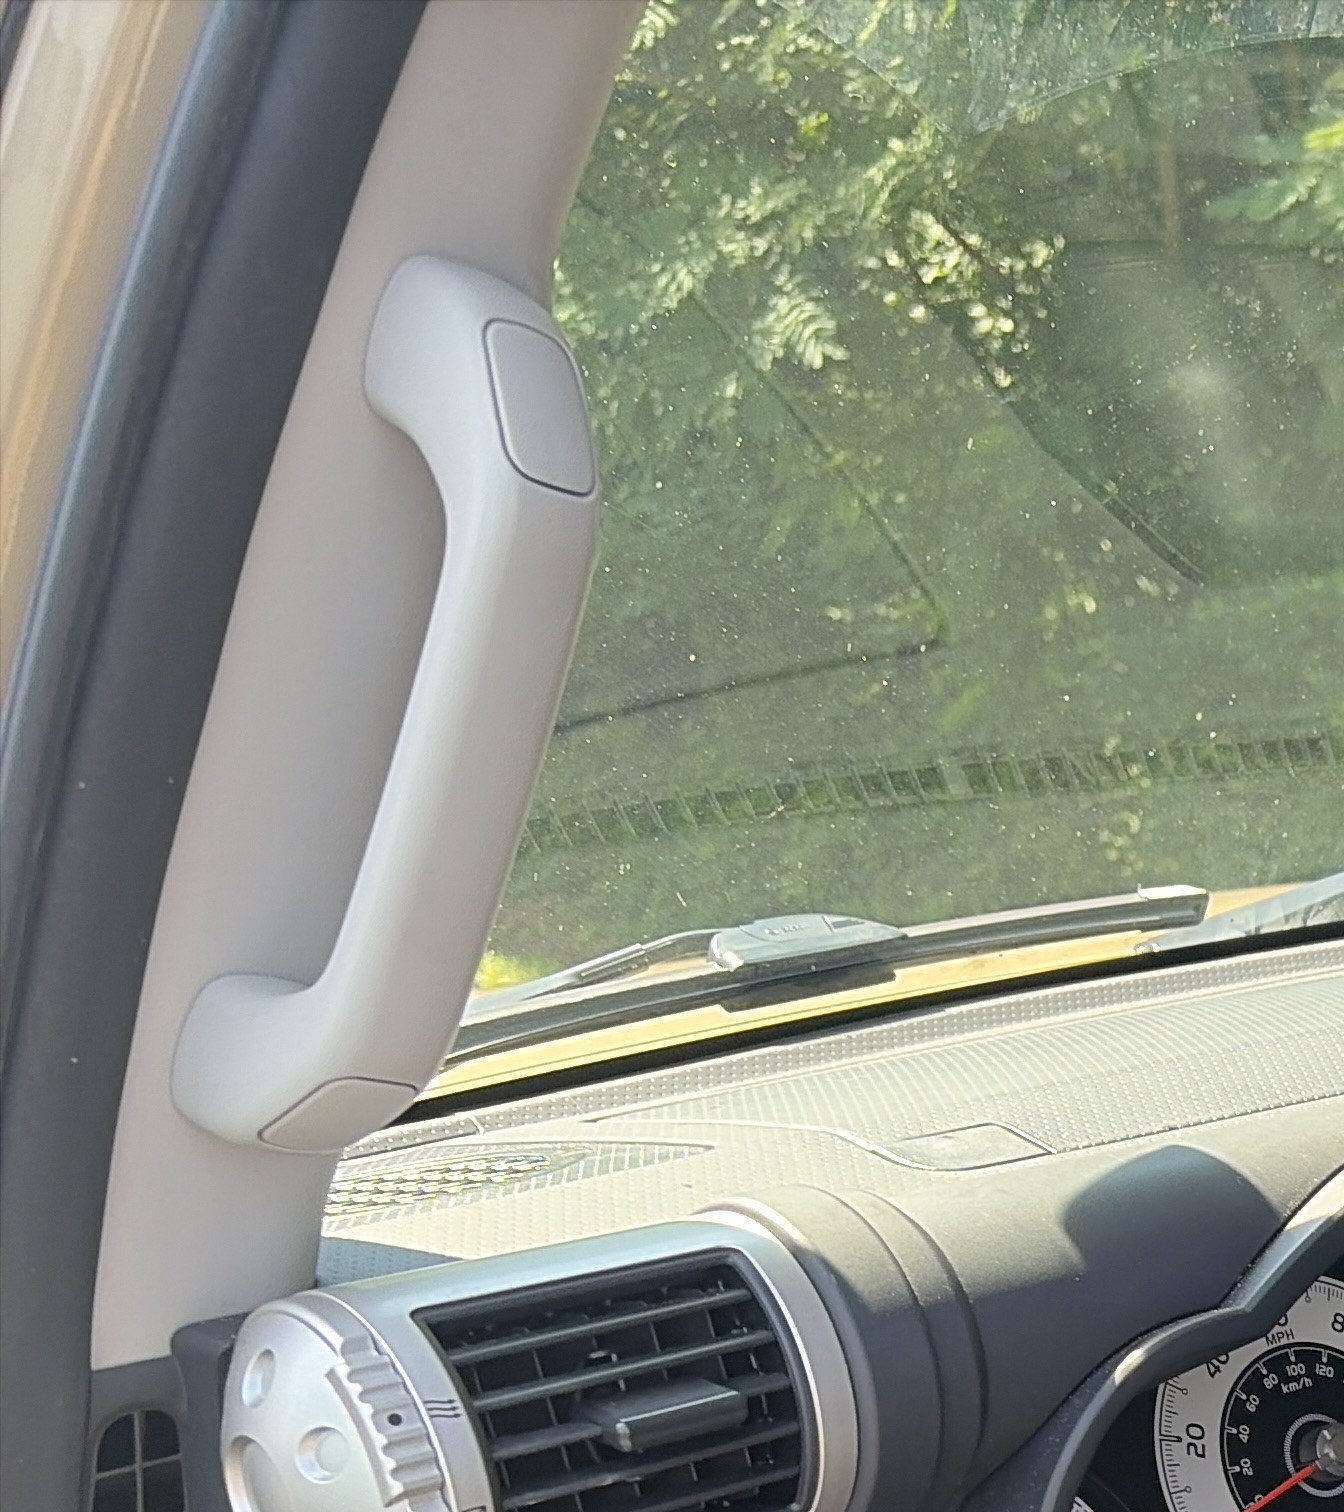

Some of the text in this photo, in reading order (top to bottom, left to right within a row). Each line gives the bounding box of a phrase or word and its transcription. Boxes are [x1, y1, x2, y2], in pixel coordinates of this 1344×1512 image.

[1265, 1328, 1295, 1347] MPH
[1286, 1363, 1306, 1377] 100
[1315, 1363, 1334, 1378] 120
[1262, 1374, 1279, 1389] 80
[1281, 1376, 1313, 1394] km/h
[1245, 1394, 1260, 1412] 60
[1185, 1423, 1206, 1459] 20
[1238, 1425, 1250, 1443] 40
[1242, 1458, 1254, 1476] 20
